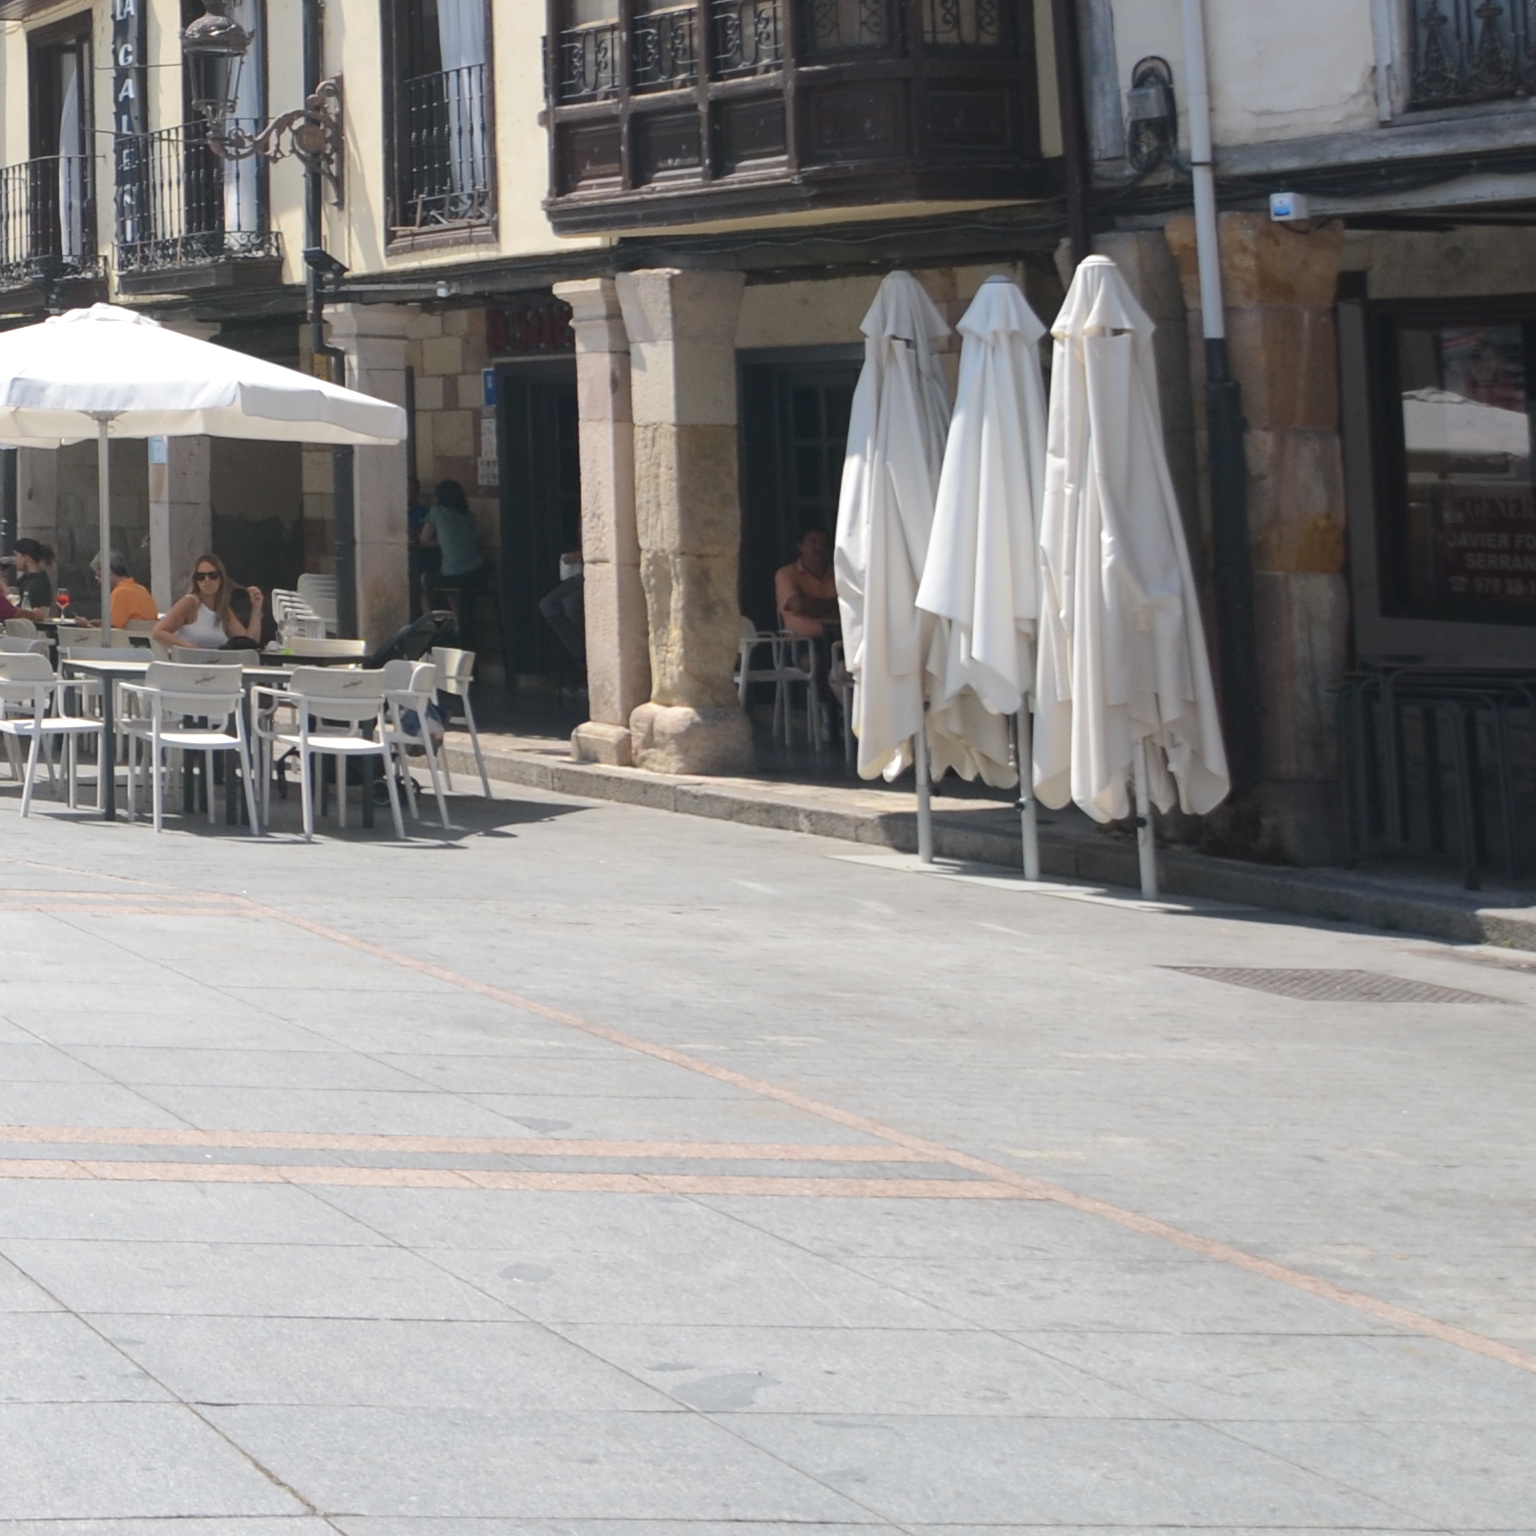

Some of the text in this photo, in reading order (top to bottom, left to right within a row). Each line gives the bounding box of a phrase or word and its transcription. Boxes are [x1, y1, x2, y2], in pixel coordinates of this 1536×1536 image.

[117, 43, 137, 248] GALERI
[1447, 532, 1510, 550] JAVIER
[1465, 553, 1536, 572] SERRAN
